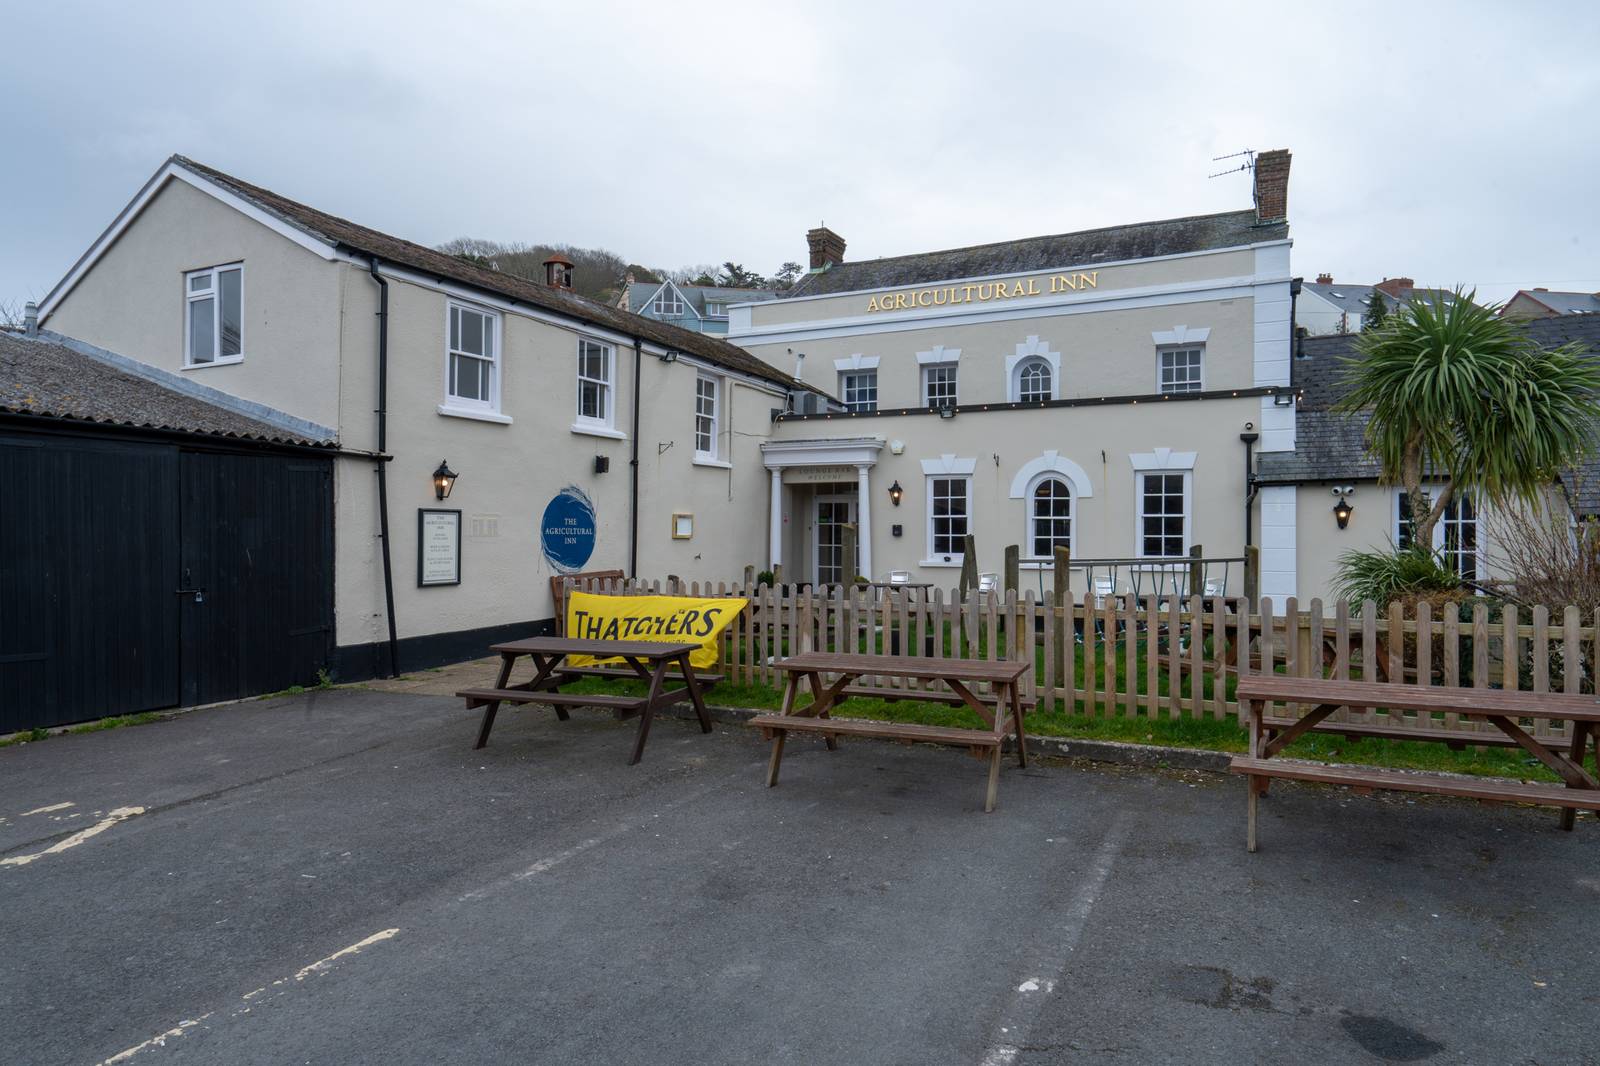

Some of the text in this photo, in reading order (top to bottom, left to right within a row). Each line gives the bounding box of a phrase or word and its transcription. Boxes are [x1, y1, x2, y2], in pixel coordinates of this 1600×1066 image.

[866, 272, 1098, 313] AGRICULTURAL INN
[564, 518, 577, 526] THE
[545, 527, 593, 535] AGRICULTURAL
[564, 537, 577, 545] INN
